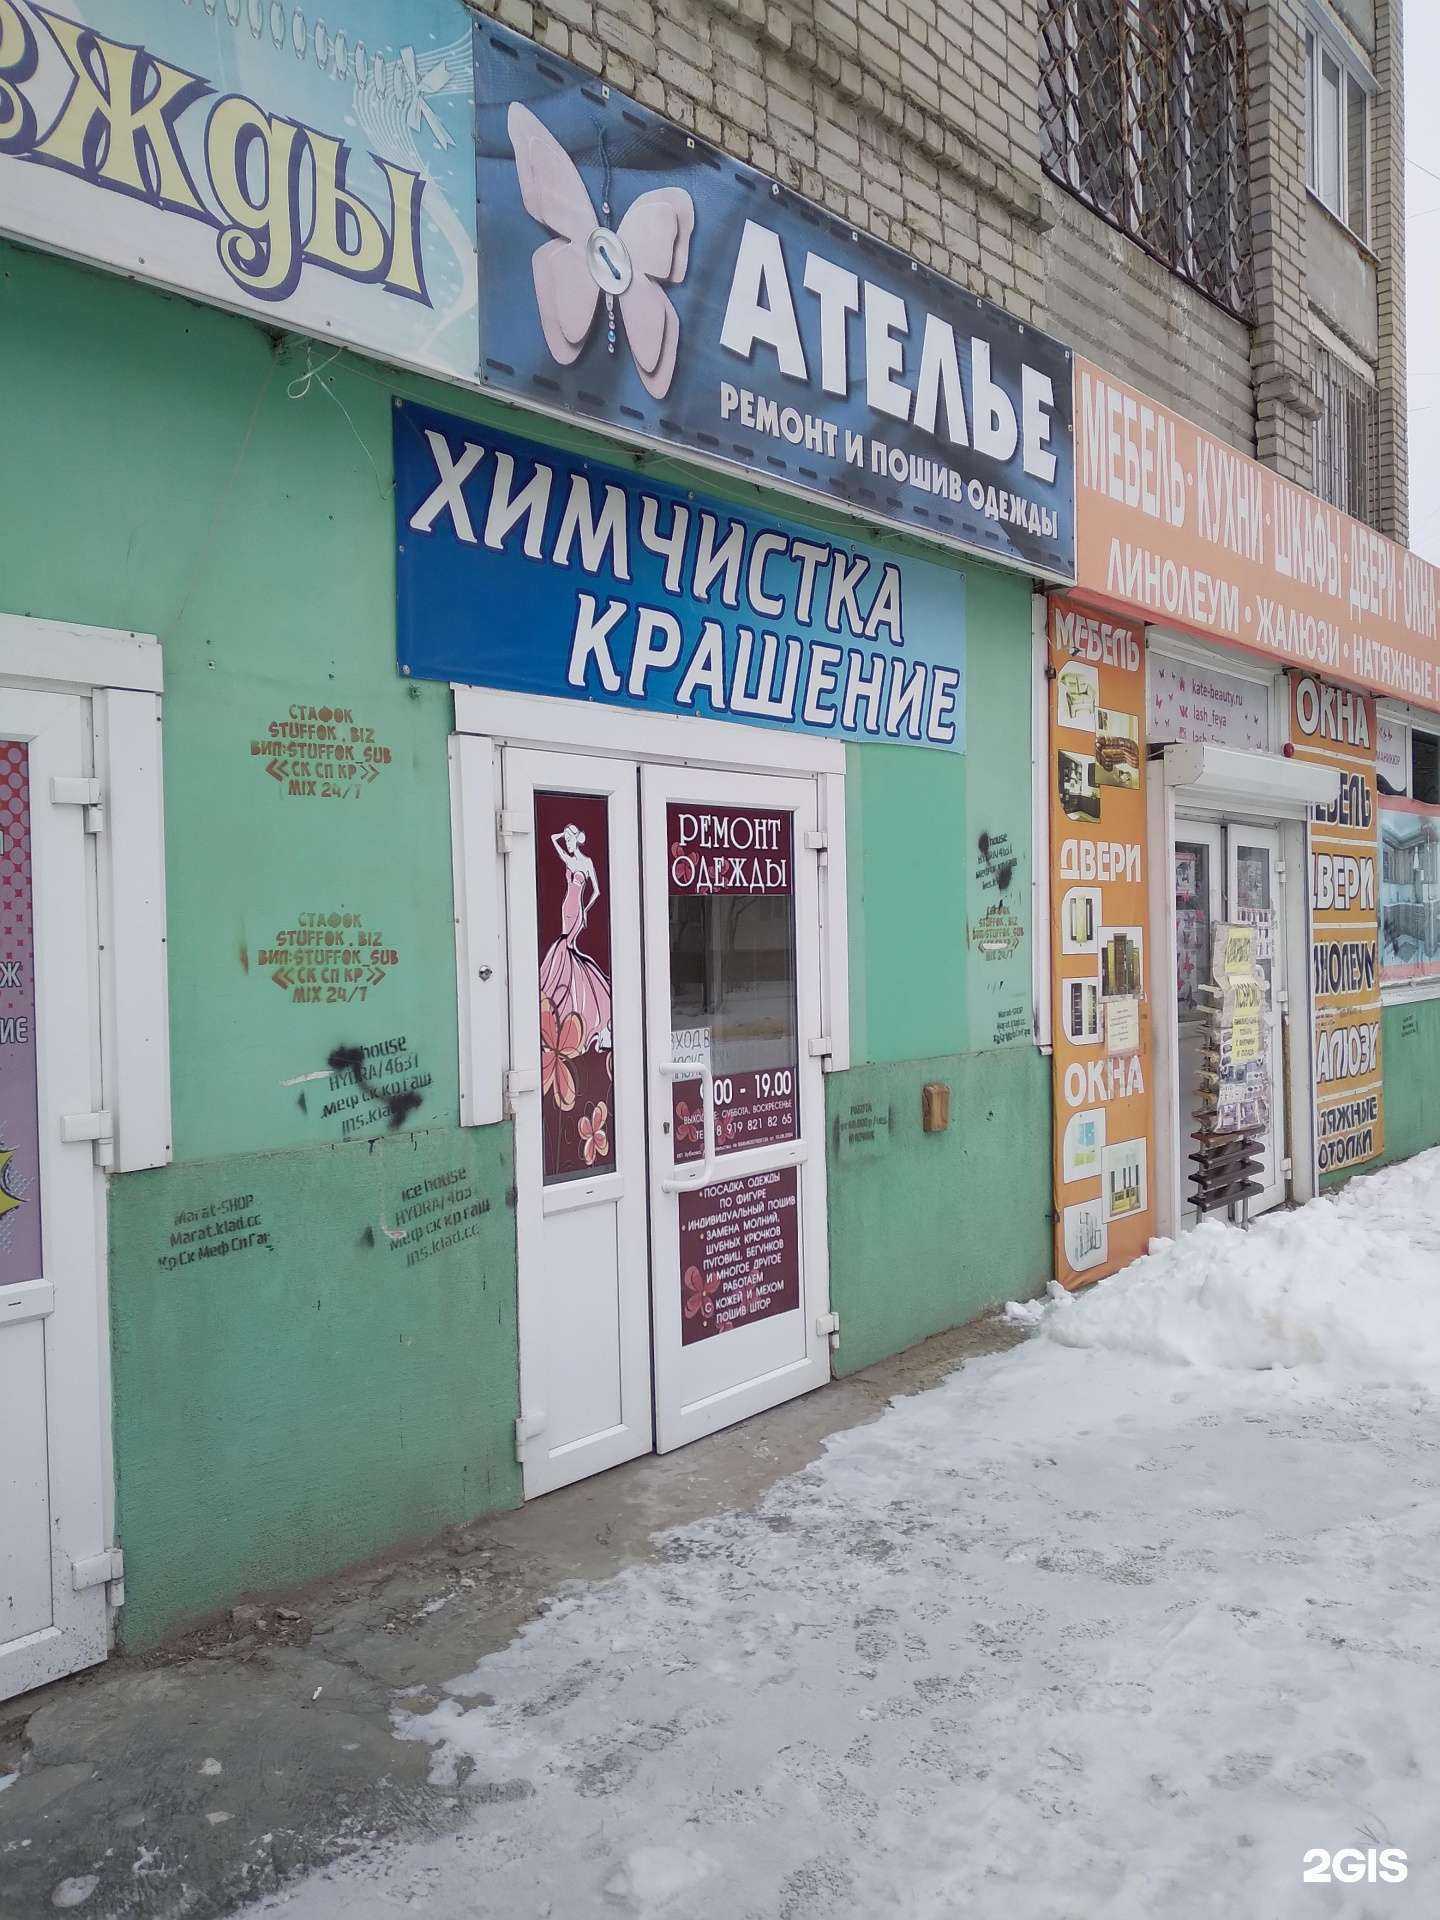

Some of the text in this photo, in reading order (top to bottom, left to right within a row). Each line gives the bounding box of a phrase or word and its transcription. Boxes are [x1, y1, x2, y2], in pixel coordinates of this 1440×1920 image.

[719, 217, 1058, 485] АТЕЛЬЕ
[719, 381, 1059, 541] РЕМОНТ И ПОШИВ ОДЕЖДЫ
[1082, 370, 1437, 641] МЕБЕЛЬ КУХНИ ШКАФЫ ДВЕРИ ОКНА
[408, 428, 905, 647] ХИМЧИСТКА
[1107, 537, 1241, 634] ЛИНОЛЕУМ
[1256, 596, 1341, 668] ЖАЛЮЗИ
[1353, 634, 1433, 699] НАТЯЖНЫЕ
[1055, 608, 1140, 672] МЕБЕЛЬ
[566, 592, 961, 744] КРАШЕНИЕ
[1192, 678, 1243, 707] kate-beauty.ru
[1193, 704, 1227, 729] lash_feya
[1296, 678, 1370, 749] ОКНА
[288, 779, 317, 796] MIX
[678, 813, 781, 850] РЕМОНТ
[671, 855, 788, 894] ОДЕЖДЫ
[1060, 838, 1142, 883] ДВЕРИ
[292, 986, 322, 1004] MIX
[1316, 1022, 1380, 1084] АЛЮЗИ
[754, 1070, 792, 1100] 19.00
[1064, 1055, 1145, 1108] ОКНА
[752, 1099, 792, 1114] ВОСКРЕСЕНЬЕ
[716, 1124, 722, 1137] 8
[726, 1121, 743, 1134] 919
[747, 1118, 763, 1131] 821
[767, 1115, 778, 1127] 82
[782, 1113, 792, 1125] 65
[1317, 1129, 1373, 1170] ОТОЛКИ
[704, 1172, 781, 1198] ПОСАДКА ОДЕЖДЫ
[719, 1189, 767, 1209] ПО ФИГУРЕ
[688, 1195, 796, 1231] ИНДИВИДУАЛЬНЫЙ ПОШИВ
[706, 1225, 740, 1241] ЗАМЕНА
[706, 1226, 781, 1255] ШУБНЫХ КРЮЧКОВ
[746, 1239, 784, 1257] БЕГУНКОВ
[706, 1253, 782, 1284] И МНОГОЕ ДРУГОЕ
[723, 1272, 764, 1293] РАБОТАЕМ
[704, 1280, 784, 1313] С КОЖЕЙ И МЕХОМ
[716, 1298, 771, 1324] ПОШИВ ШТОР
